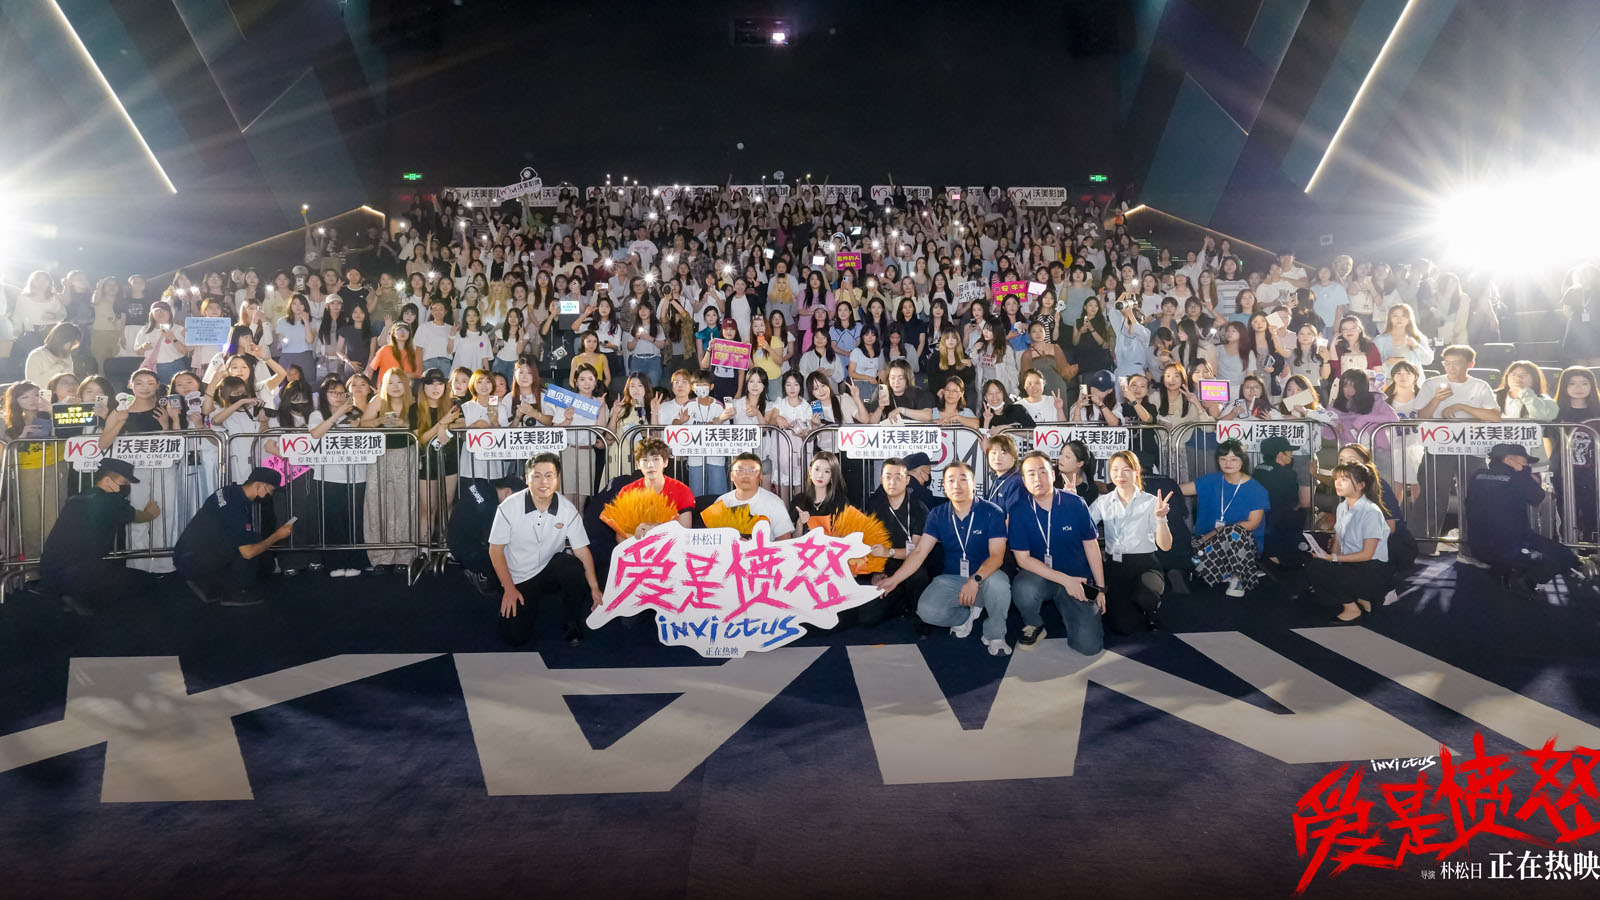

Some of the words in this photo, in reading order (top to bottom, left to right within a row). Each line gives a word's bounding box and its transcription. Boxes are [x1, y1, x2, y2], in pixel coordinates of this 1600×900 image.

[517, 179, 541, 190] 沃美影城
[1032, 189, 1065, 198] 沃美影城
[468, 432, 506, 450] WOM
[510, 431, 564, 444] 沃美影城
[666, 428, 702, 446] WOM
[706, 428, 757, 442] 沃美影城
[841, 430, 879, 448] WOM
[883, 430, 938, 444] 沃美影城
[1036, 430, 1072, 448] WOM
[1075, 430, 1126, 444] 沃美影城
[1219, 424, 1252, 441] WOM
[1256, 425, 1304, 438] 沃美影城
[1421, 426, 1465, 444] WOM
[1470, 426, 1537, 440] 沃美影城
[118, 438, 180, 454] 沃美影城
[282, 436, 322, 455] WOM
[326, 436, 382, 450] 沃美影城
[692, 533, 722, 546] 朴松日
[605, 530, 851, 622] 爱是愤怒
[705, 647, 739, 656] 正在热映
